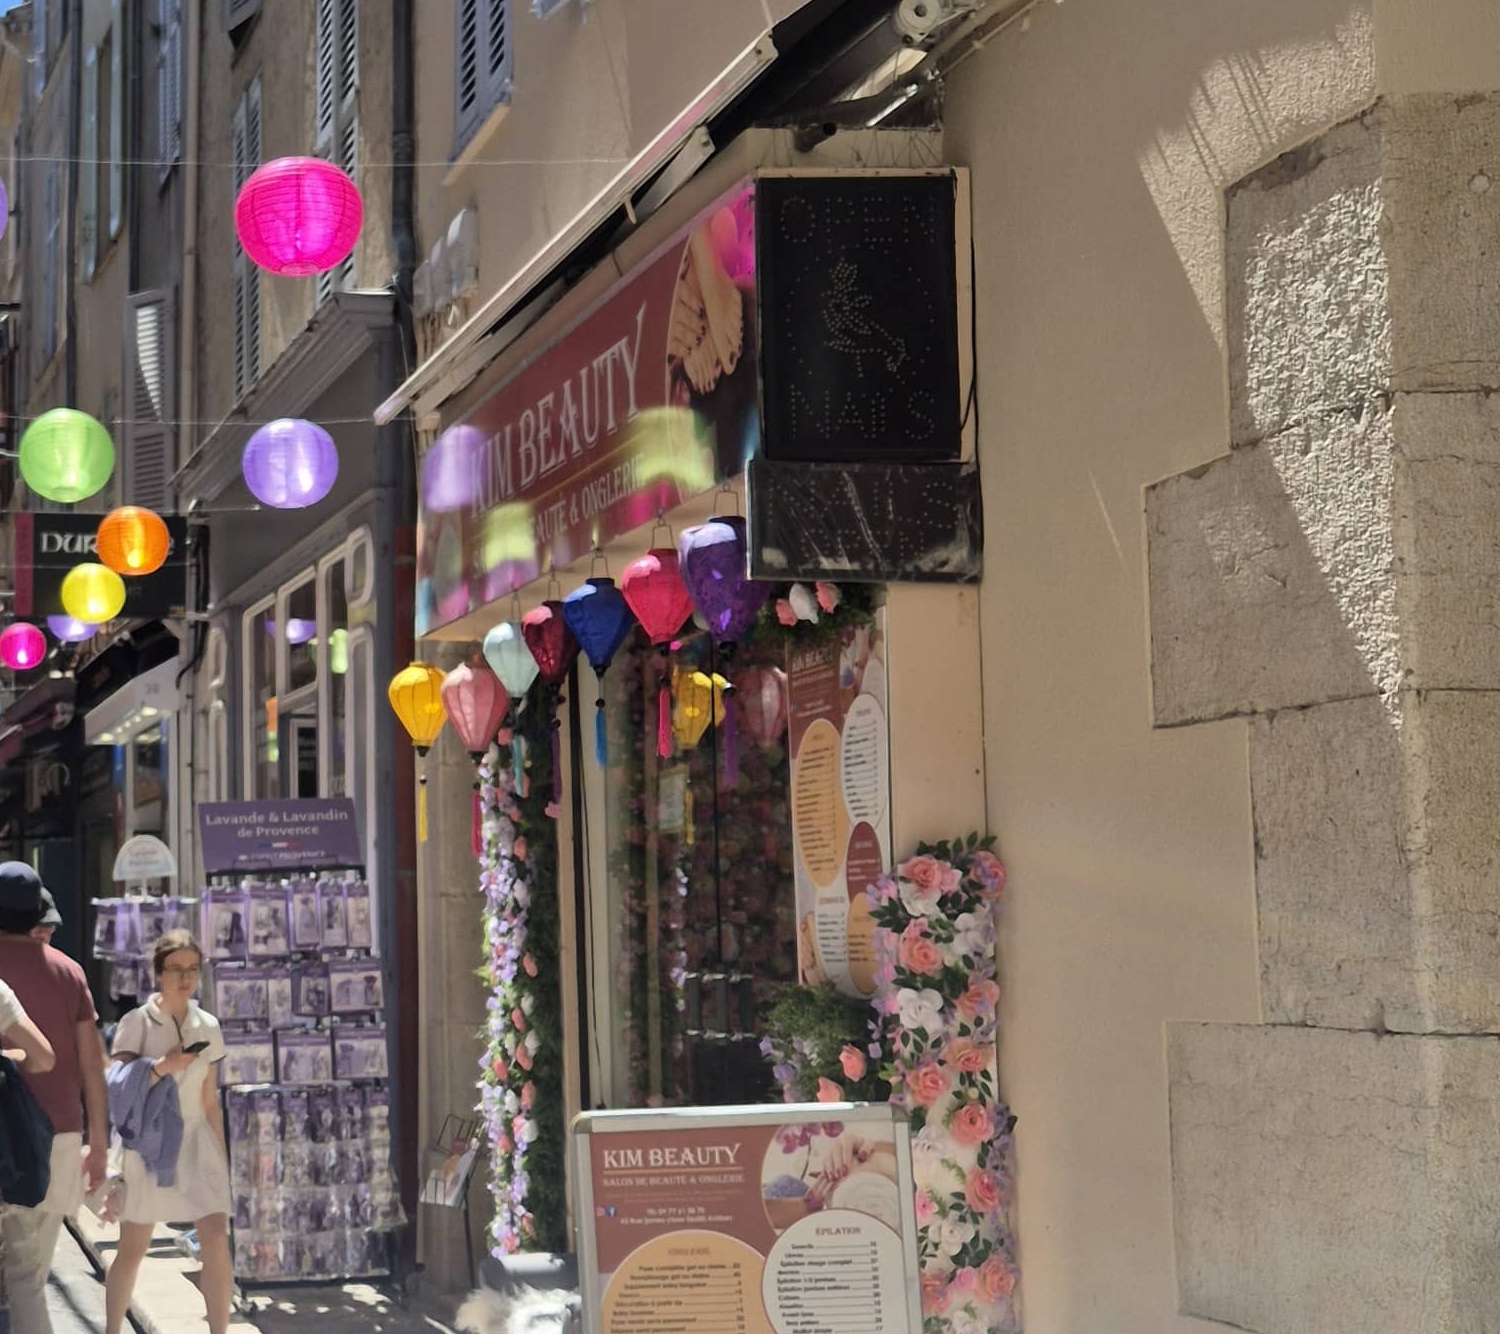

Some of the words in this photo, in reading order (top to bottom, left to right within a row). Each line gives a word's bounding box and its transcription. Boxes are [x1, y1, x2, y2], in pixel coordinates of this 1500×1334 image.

[779, 196, 936, 244] OPEN
[469, 424, 514, 519] KIM
[518, 301, 647, 491] BEAUTY
[206, 812, 265, 826] Lavande
[269, 811, 280, 823] &
[283, 808, 348, 822] Lavandin
[237, 827, 253, 838] de
[256, 824, 319, 838] Provence
[603, 1148, 643, 1168] KIM
[648, 1142, 742, 1167] BEAUTY
